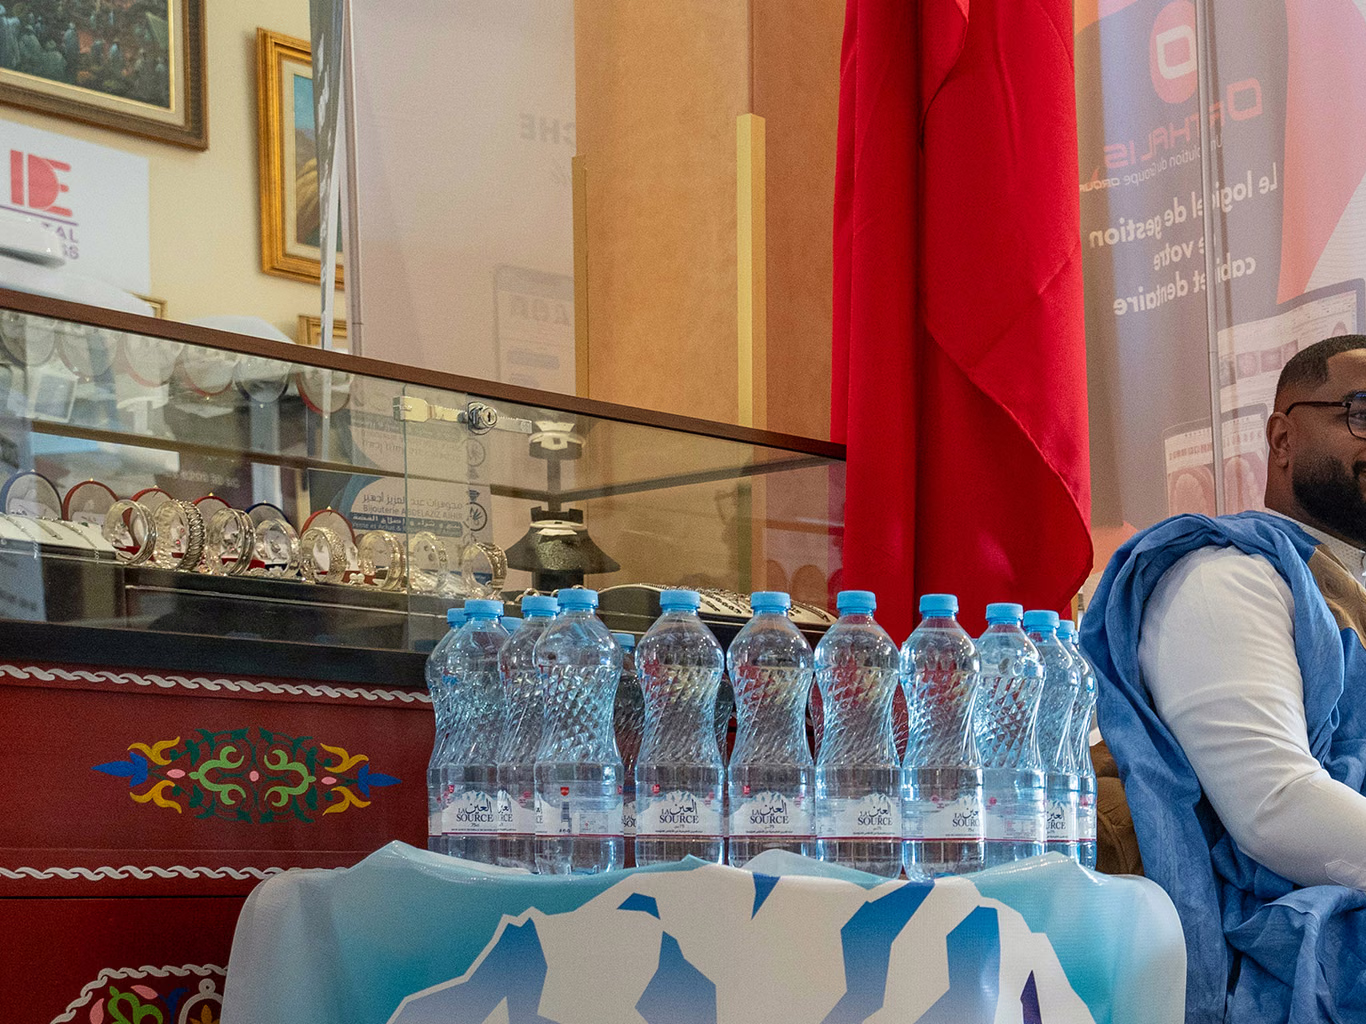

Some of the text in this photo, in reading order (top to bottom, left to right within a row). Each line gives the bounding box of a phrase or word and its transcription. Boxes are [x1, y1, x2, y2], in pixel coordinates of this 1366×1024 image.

[363, 504, 400, 514] Bijouterie
[456, 814, 494, 822] SOURCE
[659, 815, 699, 824] SOURCE
[750, 816, 790, 824] SOURCE
[858, 817, 892, 826] SOURCE
